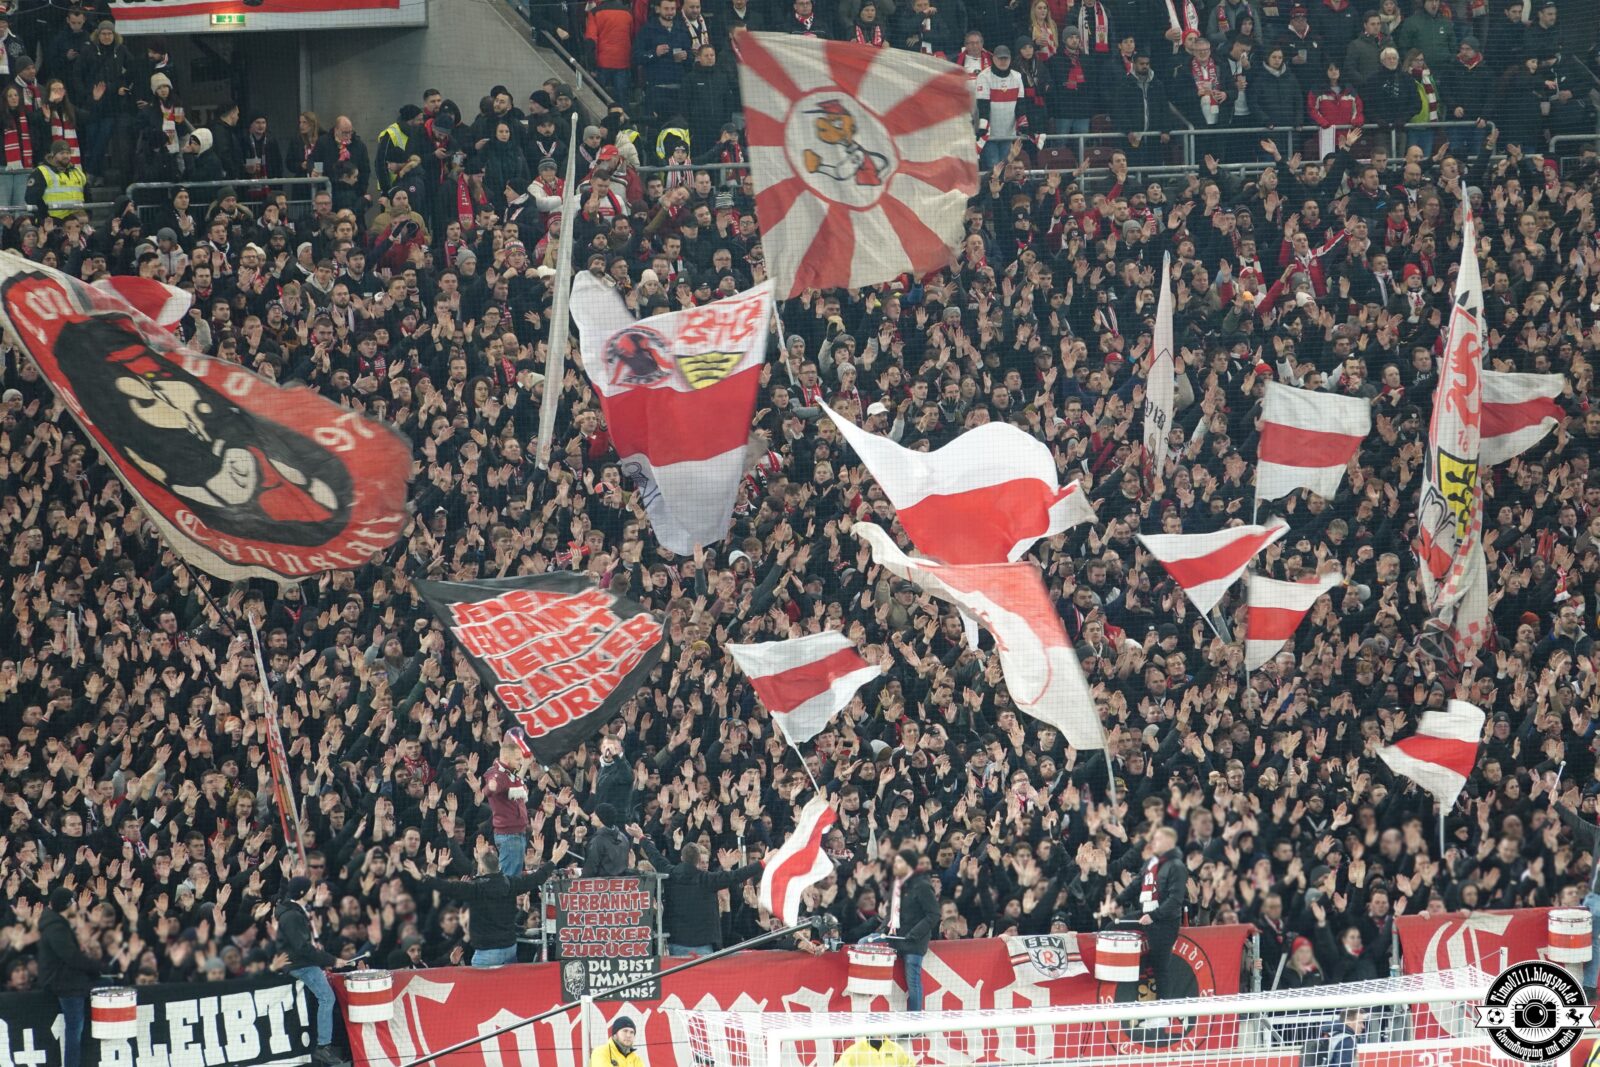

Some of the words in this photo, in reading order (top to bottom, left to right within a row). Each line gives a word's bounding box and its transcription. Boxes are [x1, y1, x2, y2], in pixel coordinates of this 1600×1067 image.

[482, 605, 624, 682] KEHRT
[568, 878, 640, 893] JEDER
[558, 891, 651, 912] VERBANNTE
[567, 910, 643, 927] KEHRT
[1027, 936, 1062, 949] SSV
[1042, 949, 1056, 964] R
[588, 959, 611, 972] DU
[618, 958, 655, 972] BIST
[620, 986, 656, 998] UNS!
